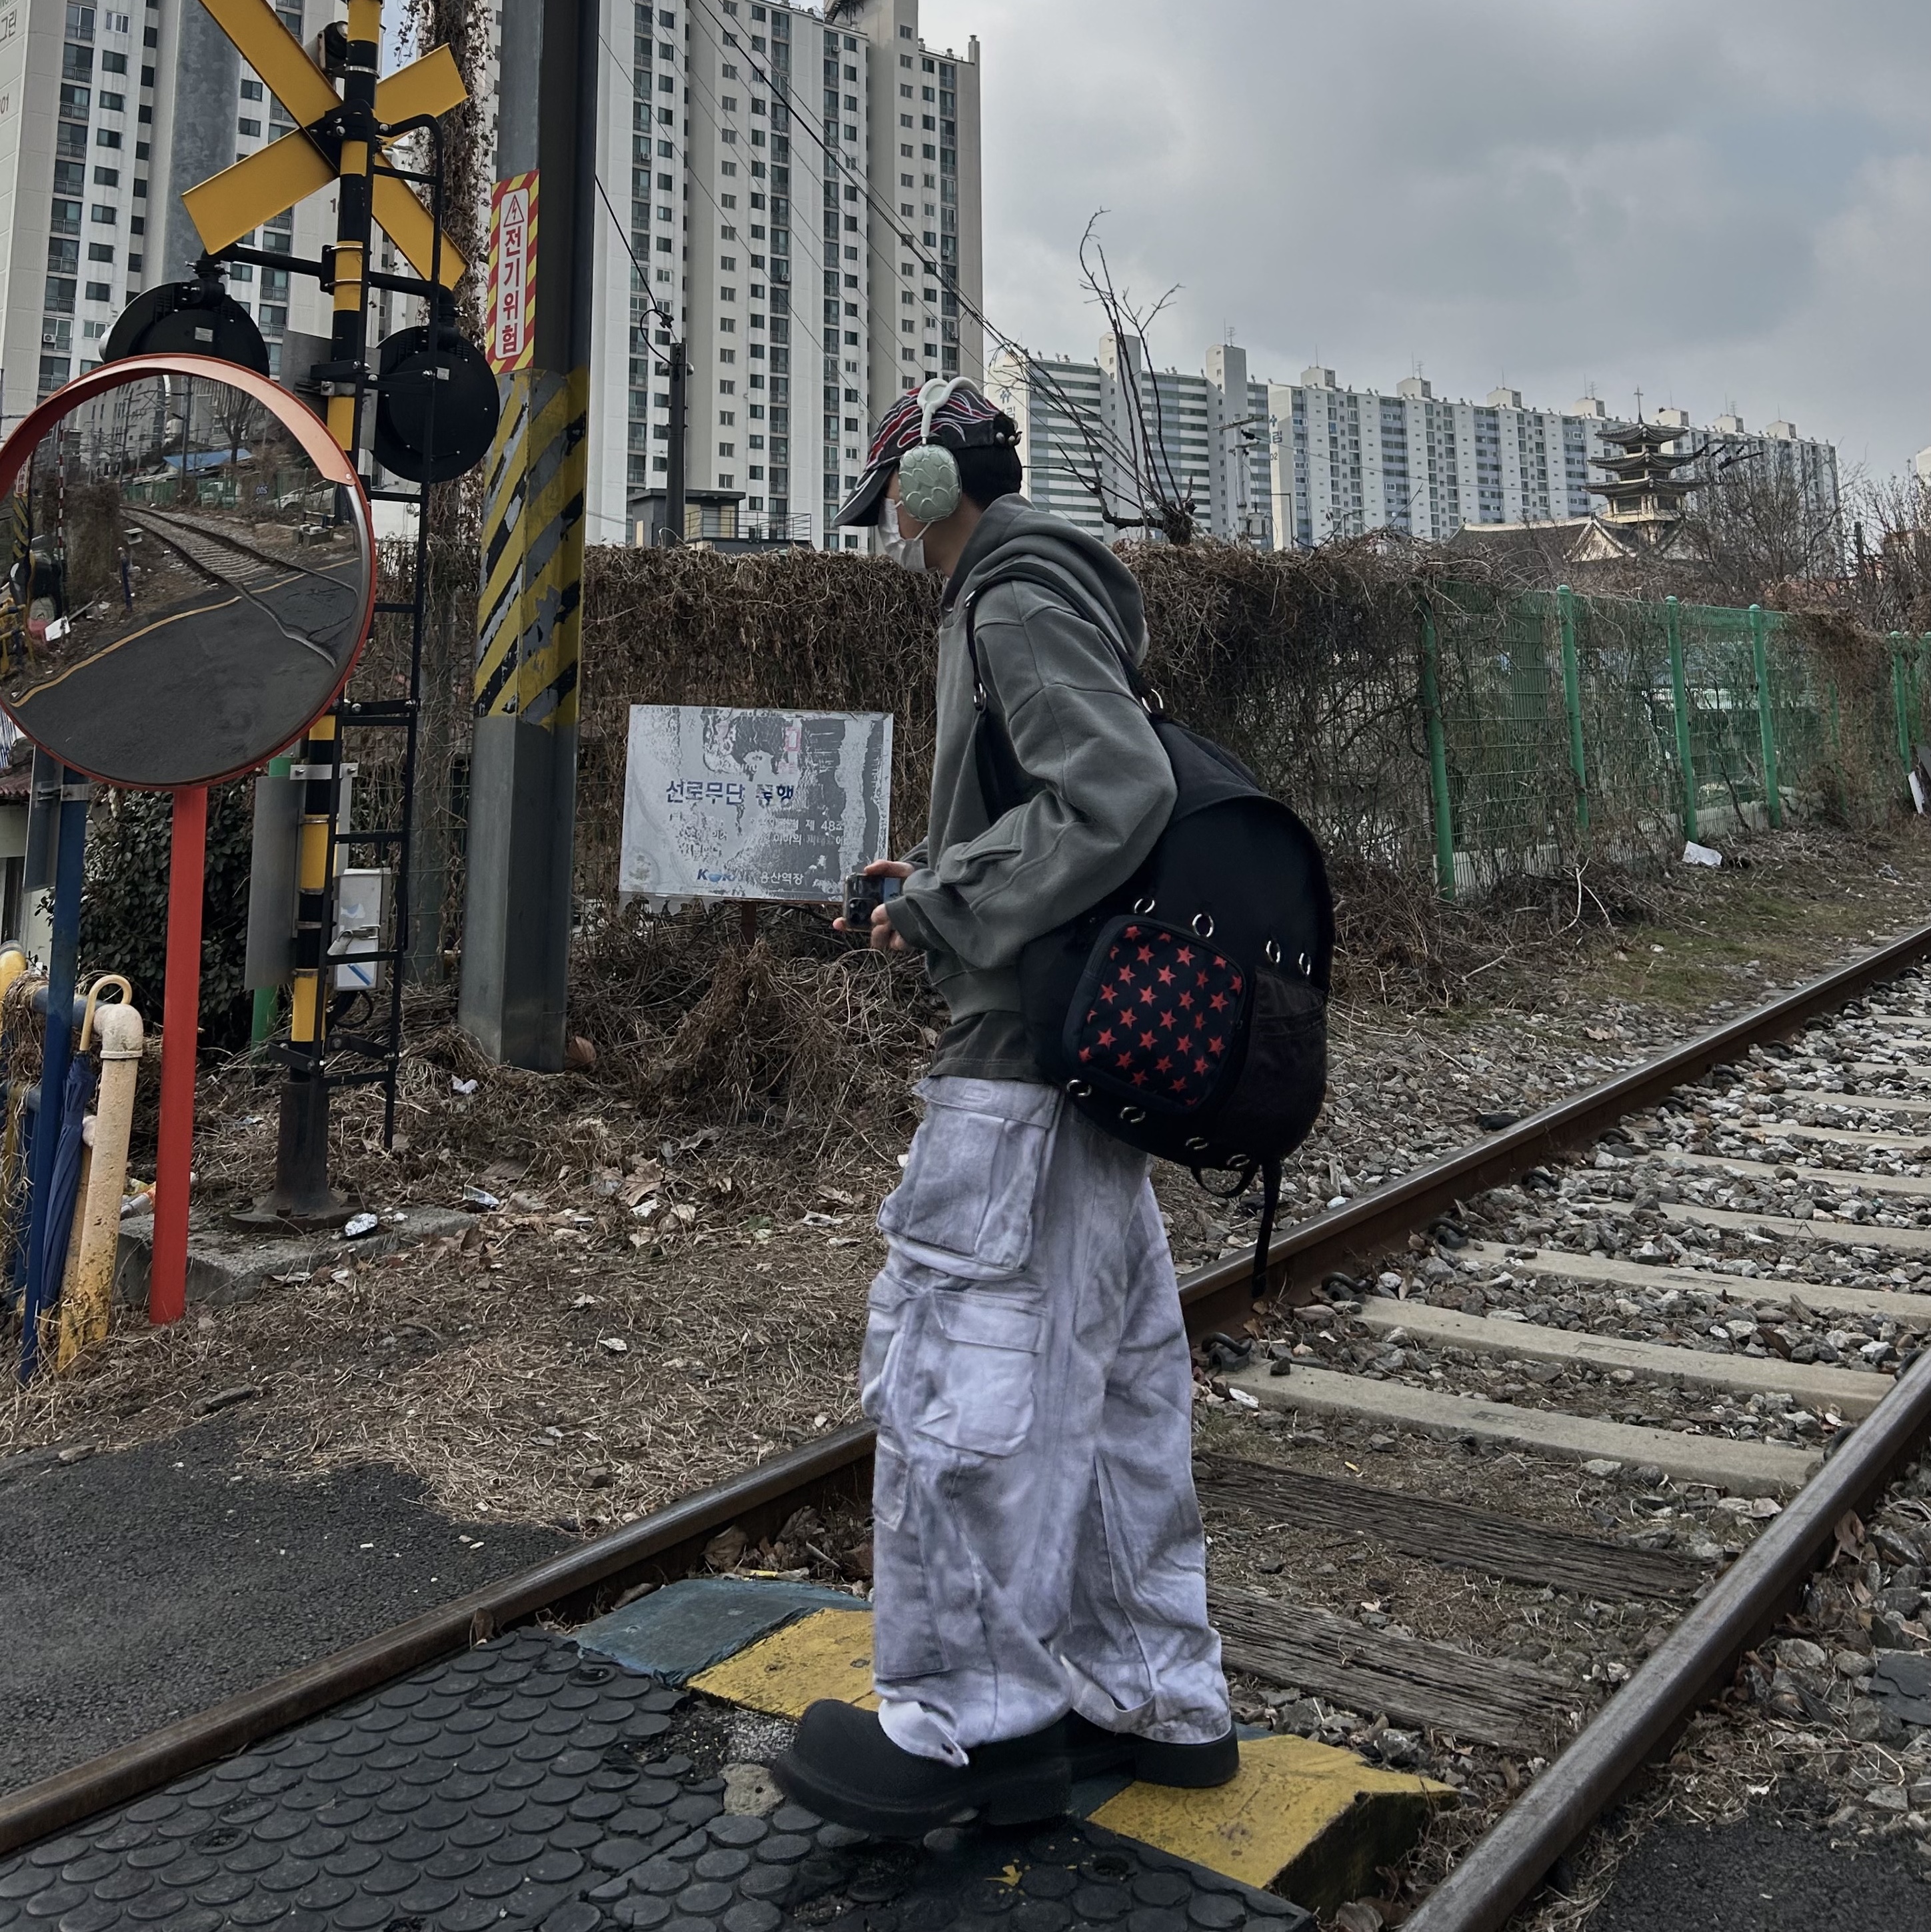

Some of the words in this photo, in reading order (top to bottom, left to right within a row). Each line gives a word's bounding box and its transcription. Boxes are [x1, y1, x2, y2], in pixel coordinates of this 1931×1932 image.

[0, 92, 10, 115] 01
[501, 226, 521, 354] 전기위험
[666, 780, 745, 805] 선로무단
[805, 819, 815, 831] 제
[759, 871, 805, 885] 용산역장
